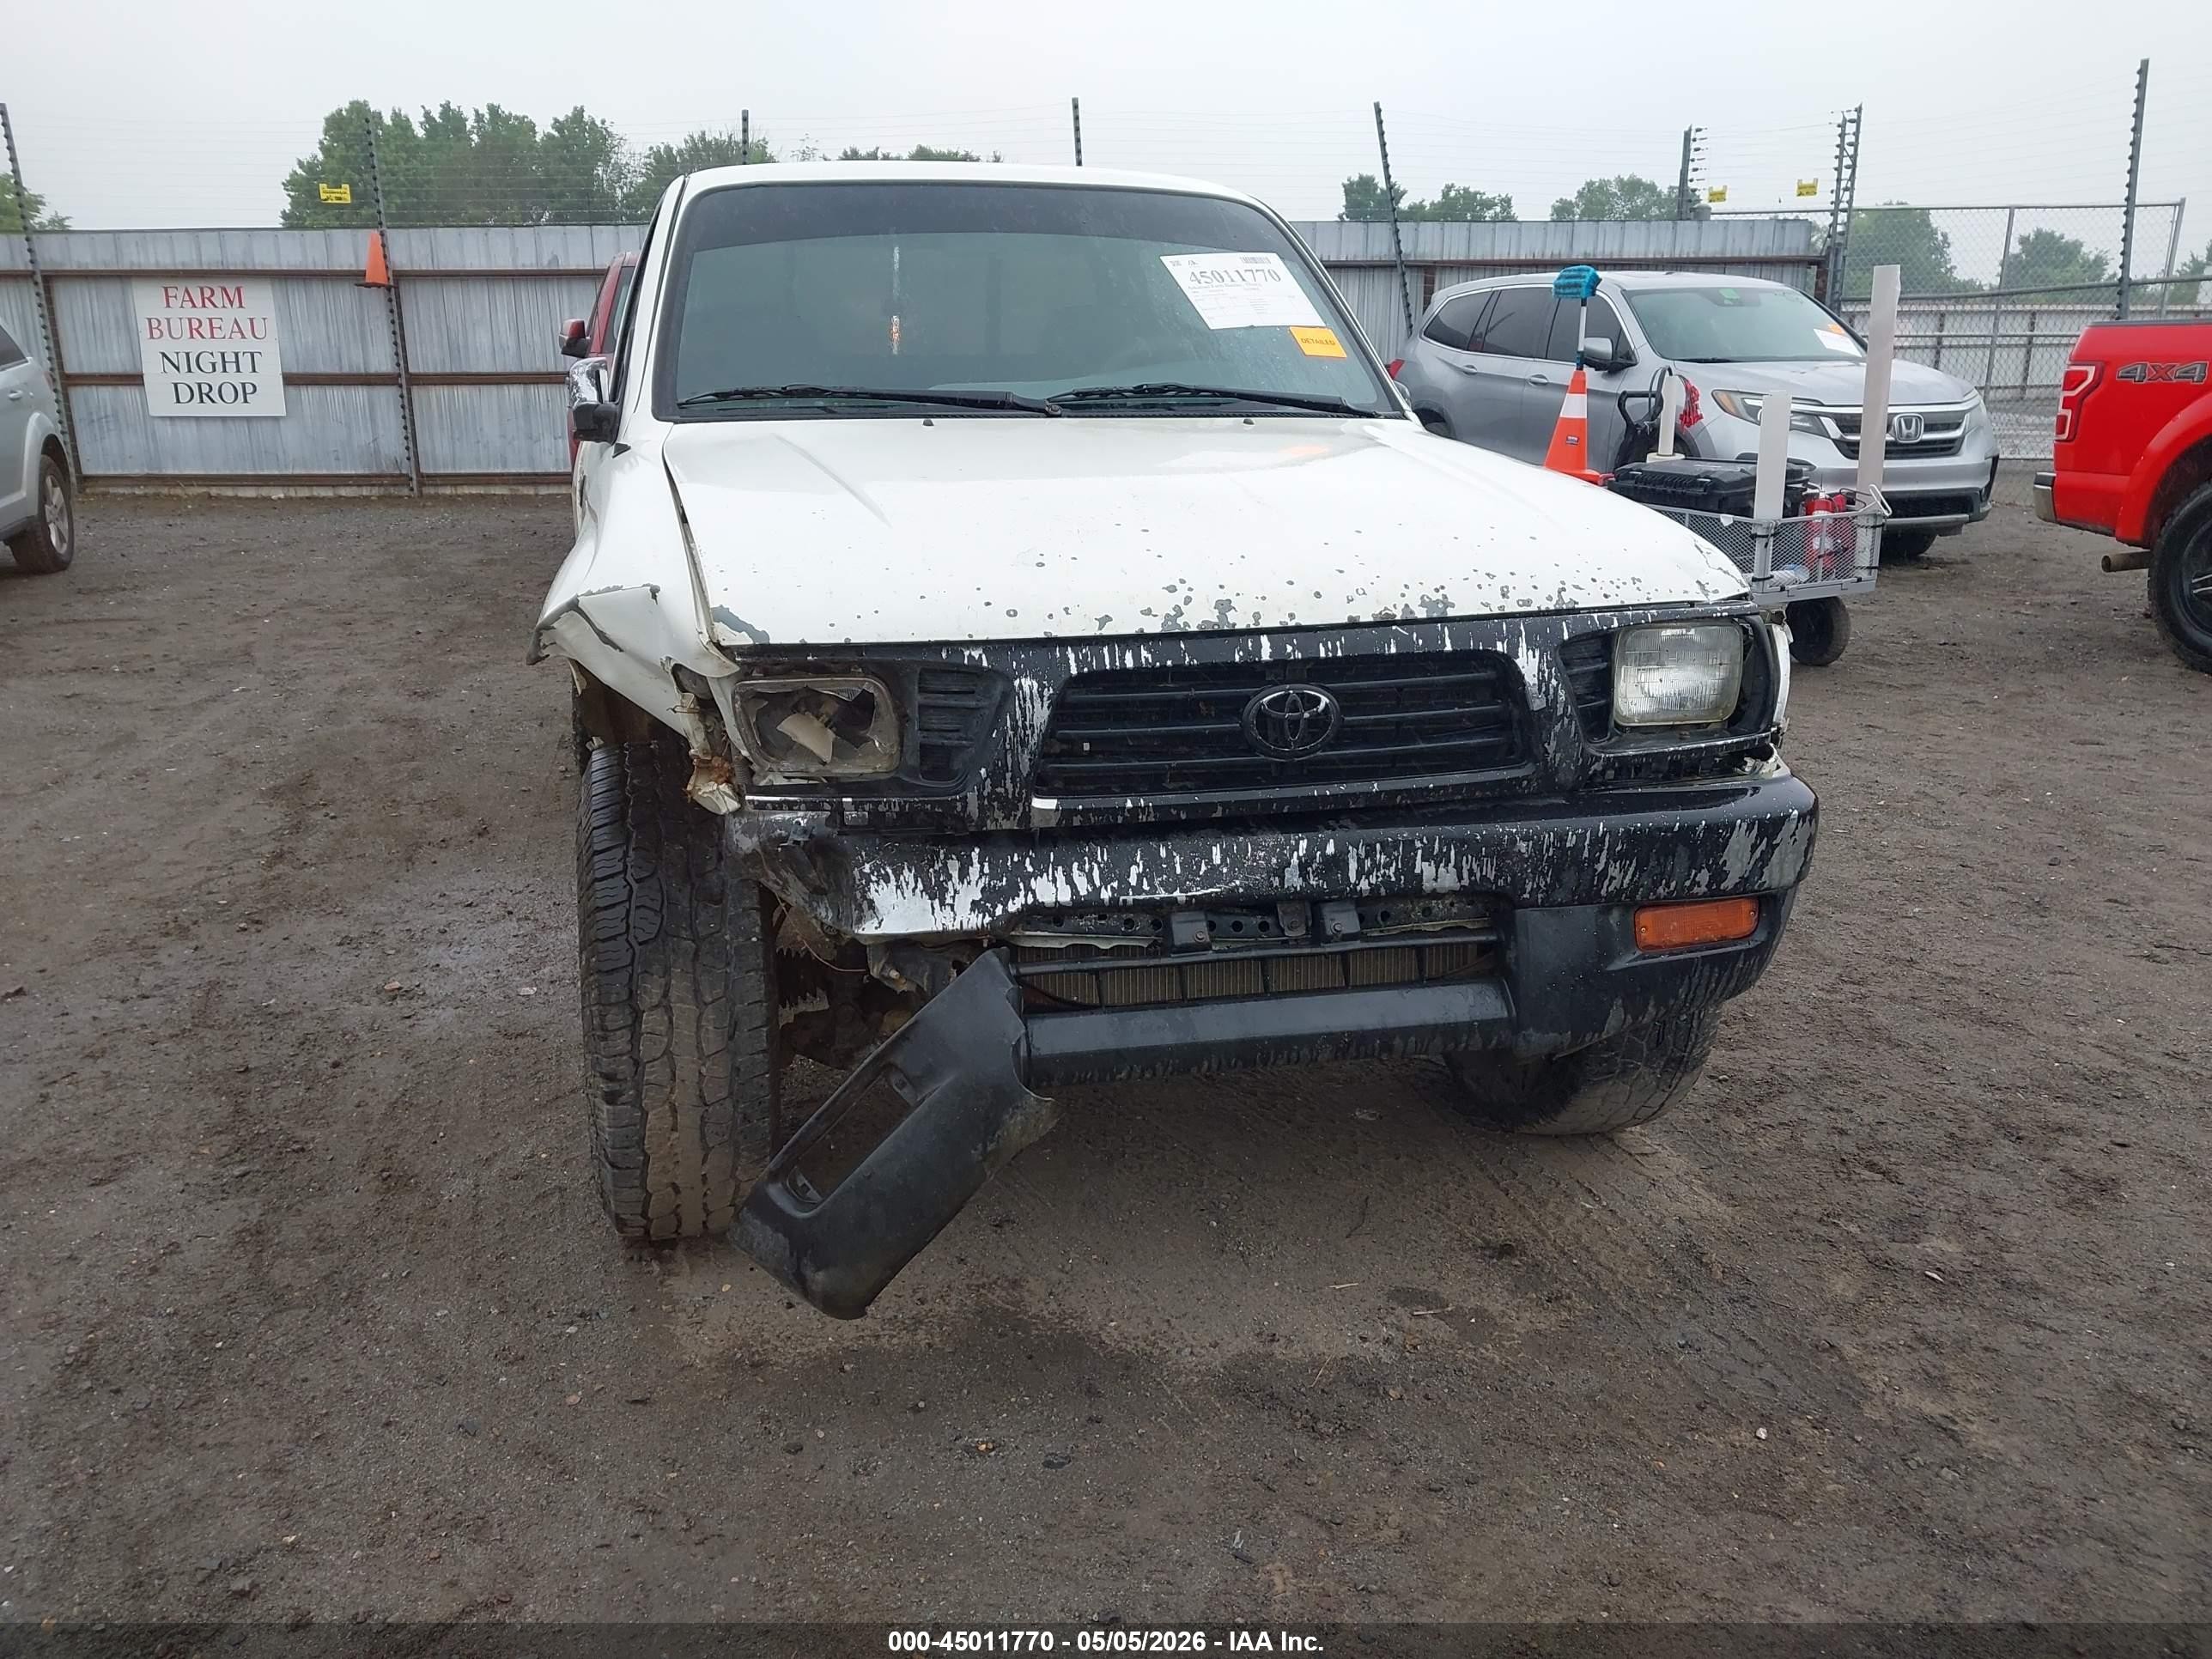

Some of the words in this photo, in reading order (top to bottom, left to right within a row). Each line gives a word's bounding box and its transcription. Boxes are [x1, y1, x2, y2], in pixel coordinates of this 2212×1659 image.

[1189, 269, 1281, 284] 45011770
[162, 286, 246, 308] FARM
[146, 316, 269, 340] BUREAU
[160, 350, 263, 374] NIGHT
[172, 381, 258, 405] DROP
